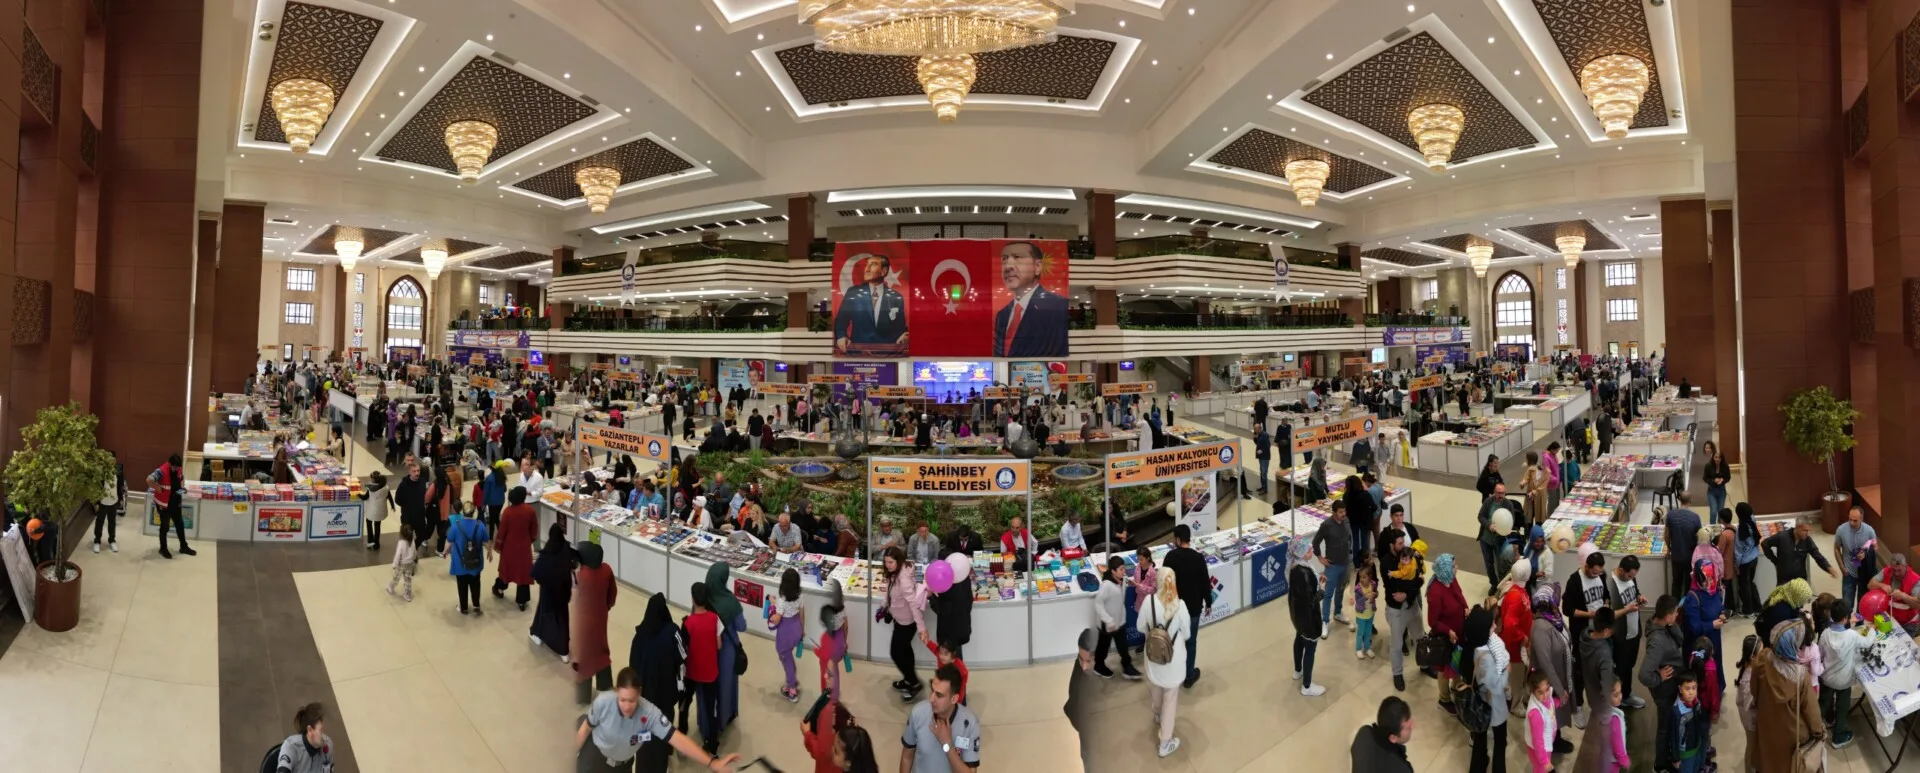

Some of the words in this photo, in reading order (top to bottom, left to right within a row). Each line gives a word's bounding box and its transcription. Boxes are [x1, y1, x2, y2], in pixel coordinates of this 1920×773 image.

[1325, 422, 1350, 434] MUTLU
[599, 429, 644, 445] GAZİANTEPLİ
[1317, 430, 1357, 445] YAYINCILIK
[603, 439, 639, 454] YAZARLAR
[1146, 453, 1175, 465] HASAN
[1177, 446, 1218, 461] KALYONCU
[919, 464, 986, 479] ŞAHİNBEY
[1155, 458, 1211, 477] ÜNİVERSİTESİ
[914, 479, 991, 491] BELEDİYESİ
